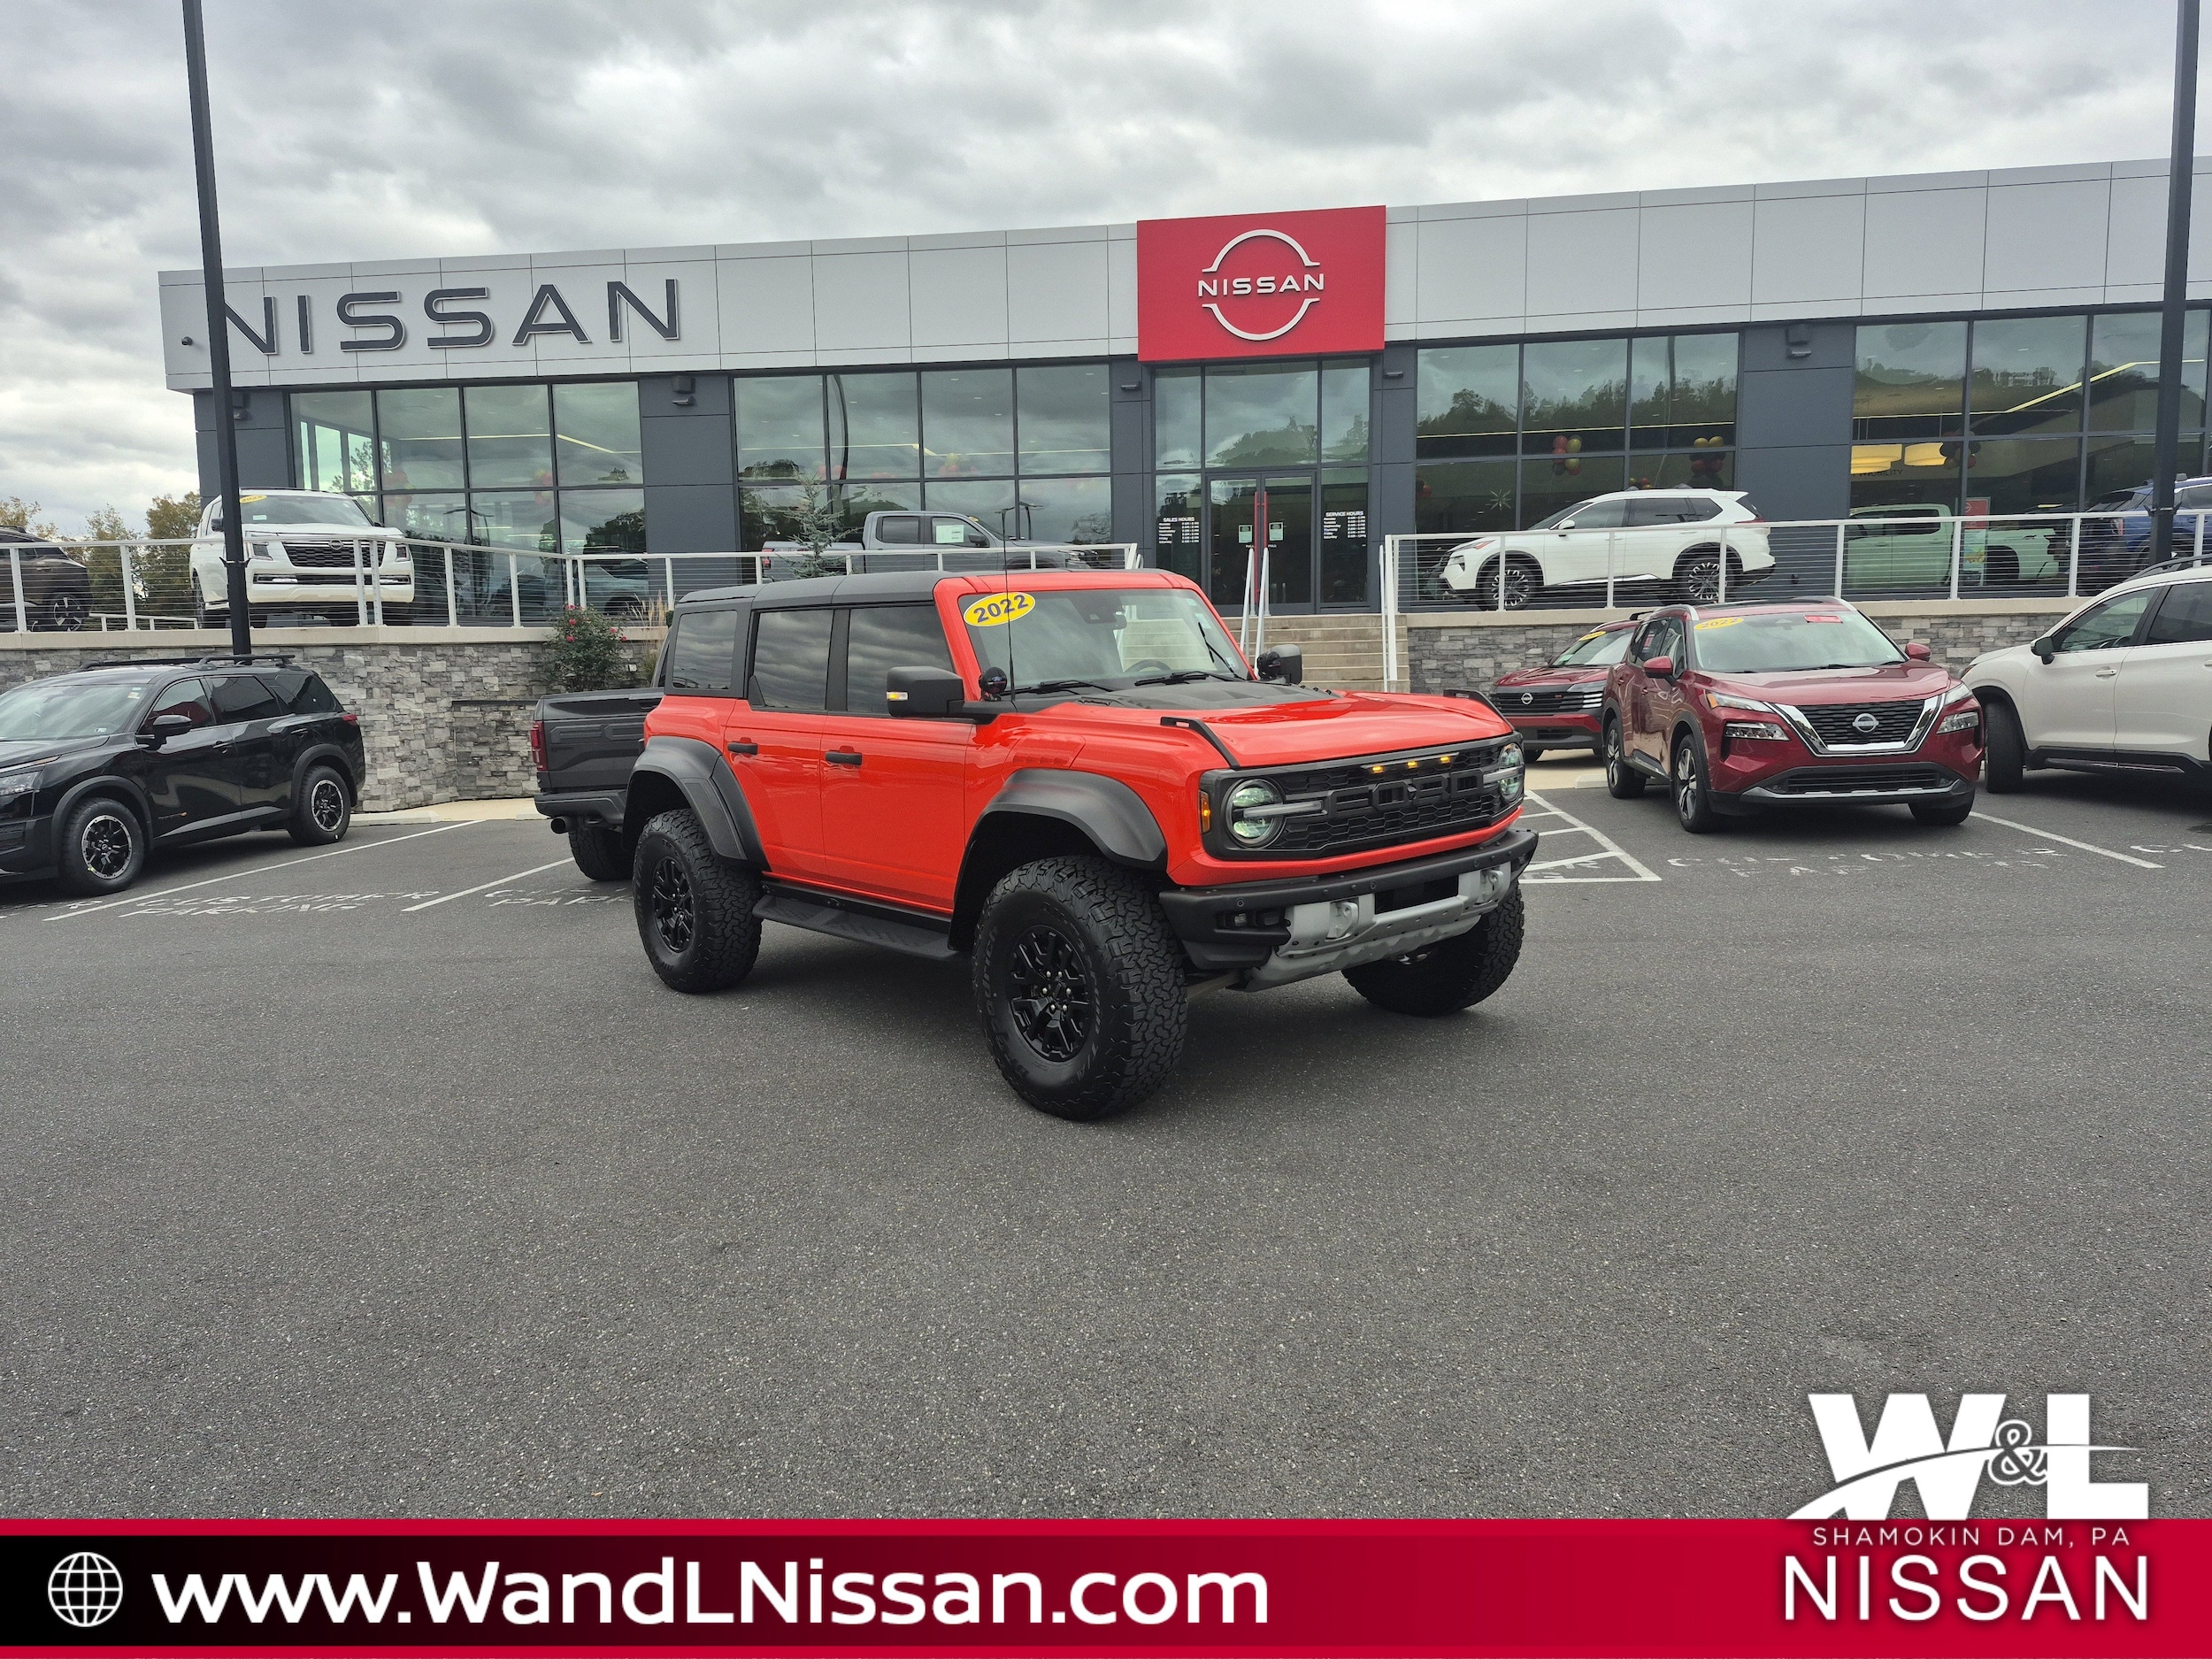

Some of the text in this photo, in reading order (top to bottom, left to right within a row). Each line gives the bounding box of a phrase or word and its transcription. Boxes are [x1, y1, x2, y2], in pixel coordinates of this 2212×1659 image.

[1198, 273, 1325, 297] NISSAN
[224, 279, 680, 355] NISSAN
[973, 595, 1029, 623] 2022
[1701, 618, 1738, 628] 2022
[1329, 768, 1484, 819] FORD
